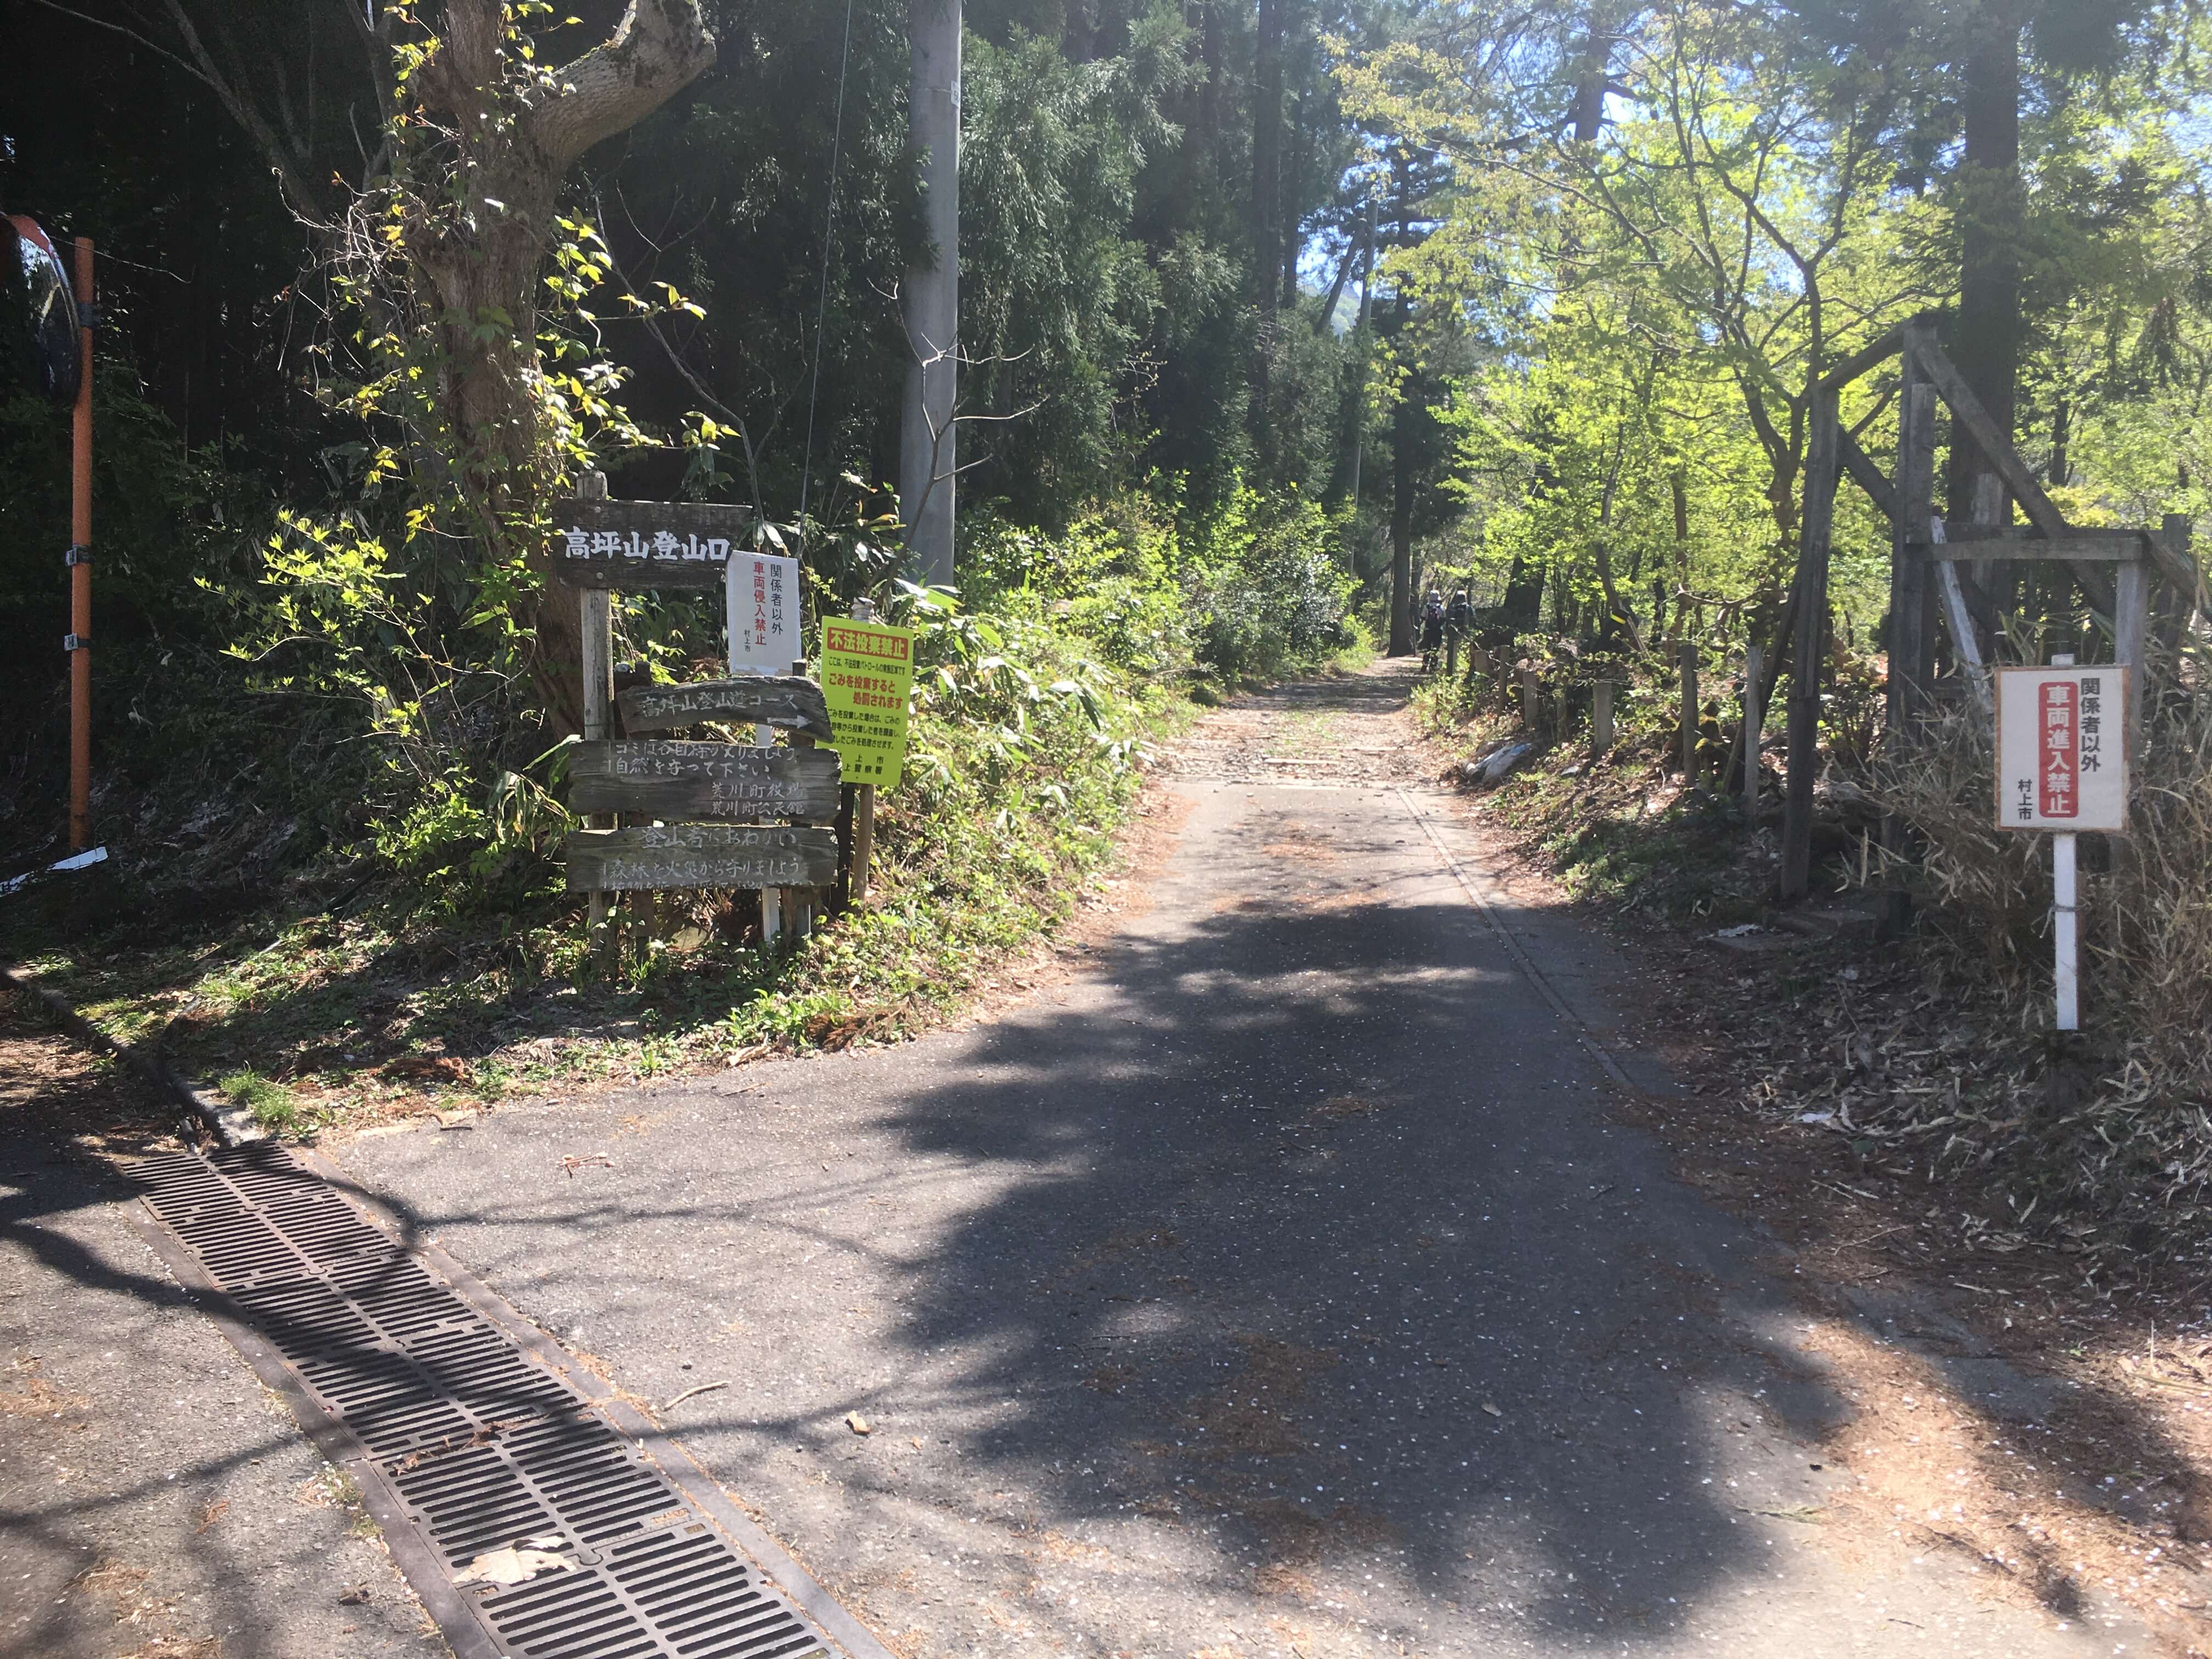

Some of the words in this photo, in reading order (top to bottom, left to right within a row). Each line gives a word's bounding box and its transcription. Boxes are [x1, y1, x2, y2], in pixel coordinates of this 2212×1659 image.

[565, 525, 731, 562] 高坪山登山口
[753, 561, 767, 646] 車両侵入禁止
[770, 563, 783, 635] 関係者以外
[830, 629, 905, 658] 不法投棄禁止
[829, 673, 896, 694] ごみを投棄すると
[853, 691, 903, 710] 処罰されます
[641, 690, 799, 717] 高坪山登山道コース
[2080, 678, 2101, 772] 関係者以外
[2046, 685, 2071, 815] 車両進入禁止
[2017, 778, 2033, 820] 村上市
